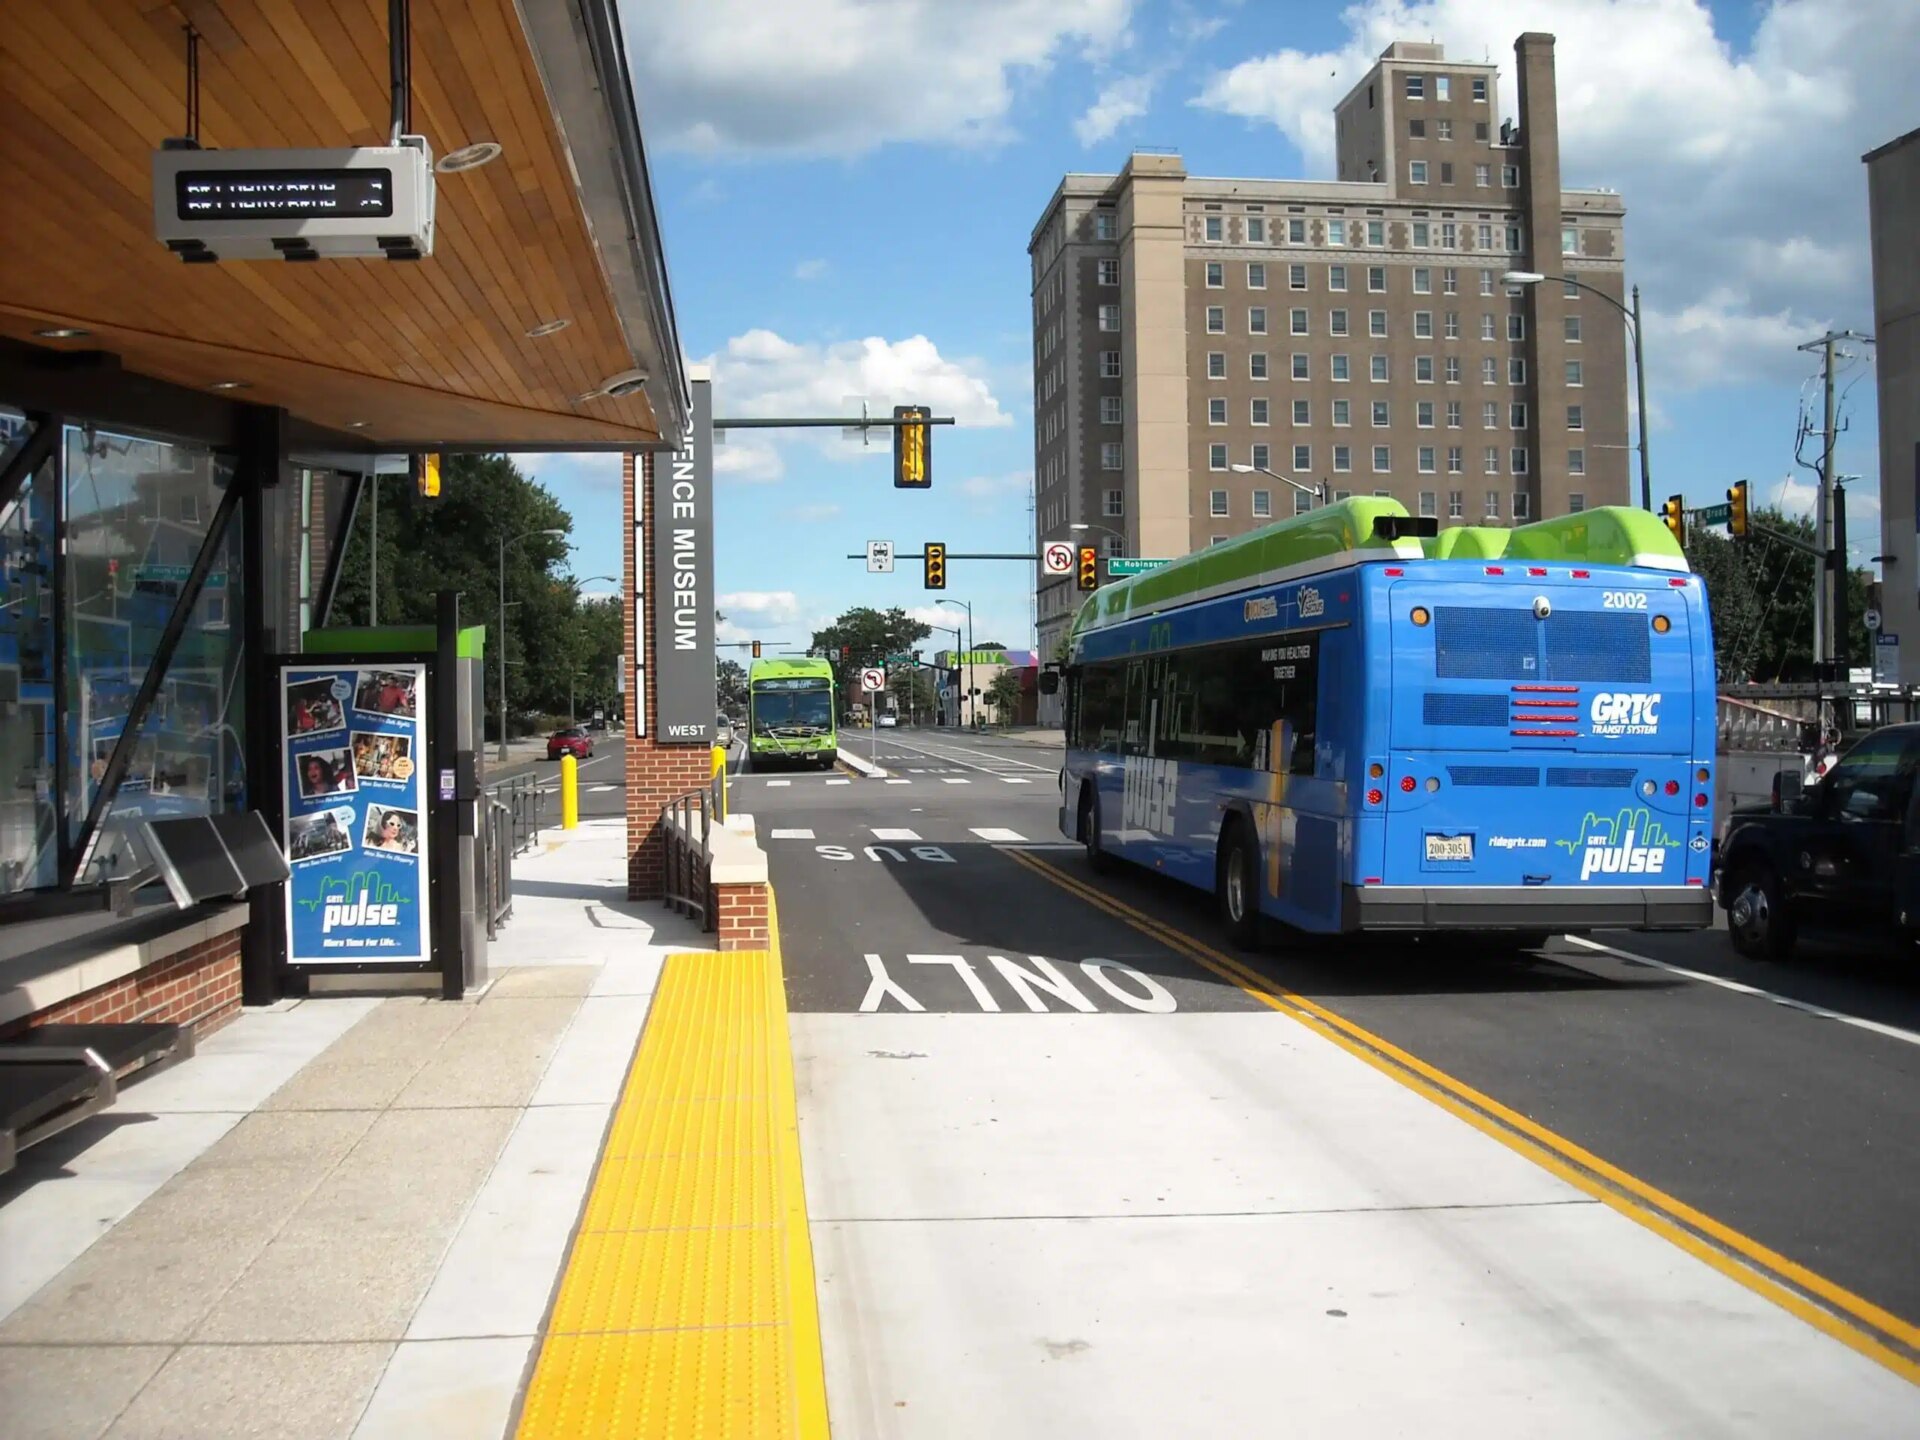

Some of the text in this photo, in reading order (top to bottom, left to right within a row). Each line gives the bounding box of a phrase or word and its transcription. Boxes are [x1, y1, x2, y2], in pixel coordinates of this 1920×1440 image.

[672, 400, 697, 650] IENCE MUSEUM
[1602, 591, 1647, 609] 2002
[1591, 692, 1661, 725] GRTC
[668, 725, 706, 736] WEST
[1592, 724, 1657, 735] TRANSIT SYSTEM
[1488, 836, 1547, 850] ridegrtc.com
[1587, 835, 1608, 846] GRTC
[814, 846, 957, 863] BUS
[1580, 829, 1666, 881] pulse
[322, 889, 398, 933] pulse
[323, 939, 345, 947] More
[345, 938, 364, 947] Time
[365, 938, 379, 947] For
[858, 953, 1178, 1014] ONLY
